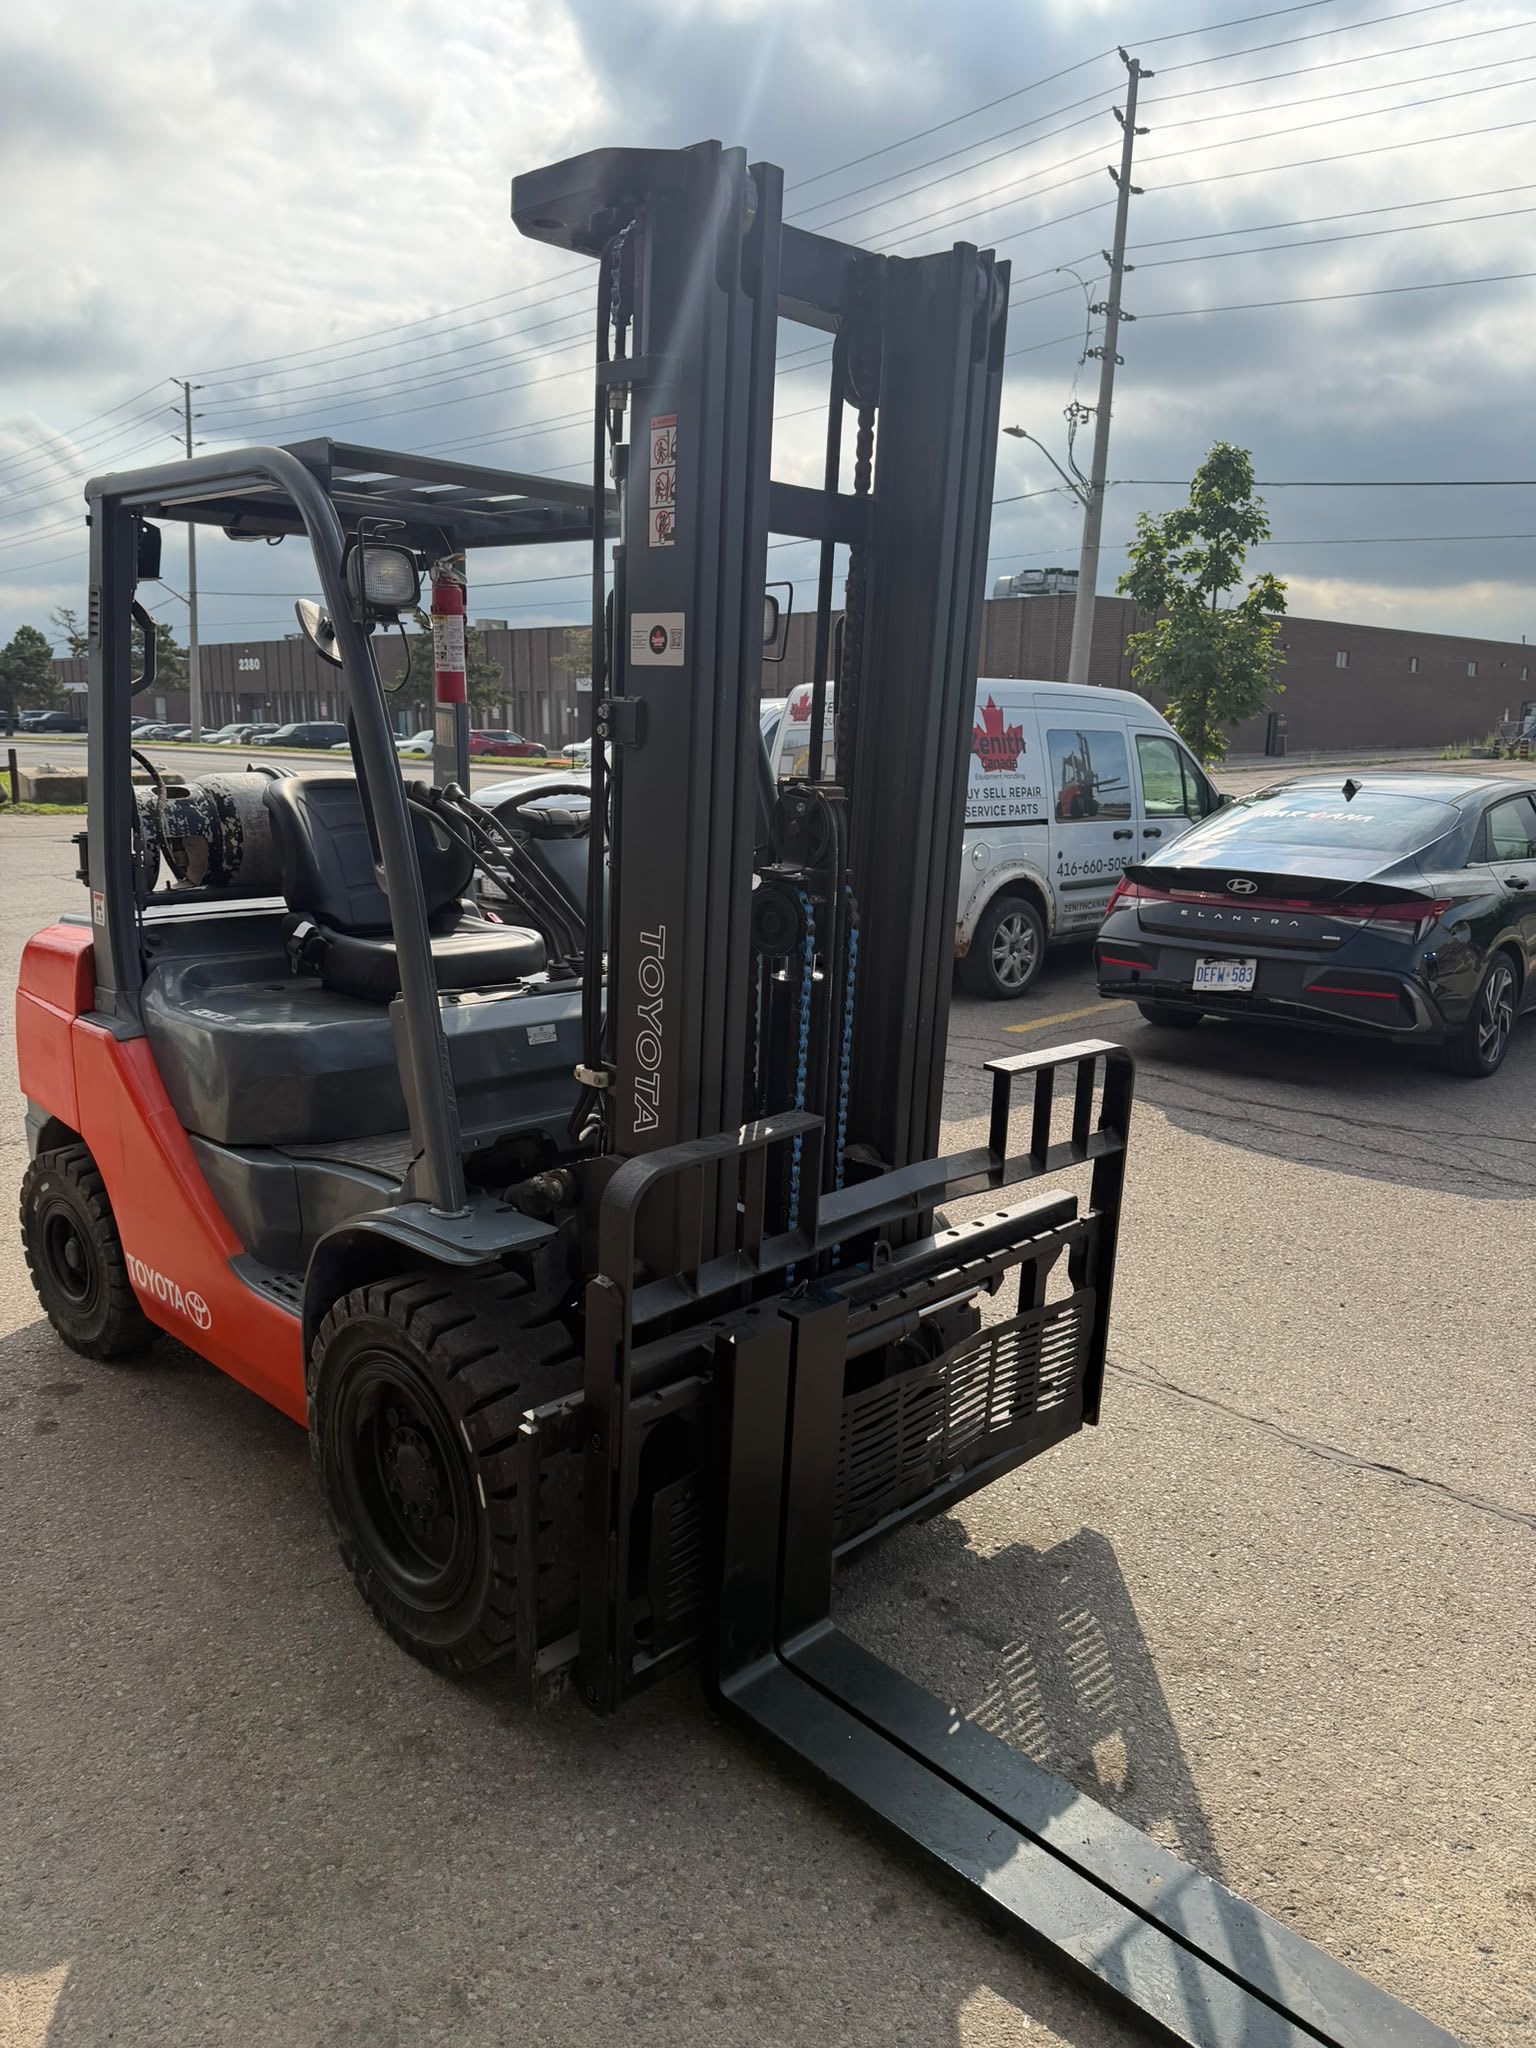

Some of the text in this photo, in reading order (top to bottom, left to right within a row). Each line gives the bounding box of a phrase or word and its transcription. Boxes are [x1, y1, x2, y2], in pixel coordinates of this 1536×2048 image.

[982, 756, 1018, 769] Canada
[975, 773, 1002, 781] Equipment
[968, 786, 1041, 799] UY SELL REPAIR
[966, 803, 1038, 817] SERVICE PARTS
[1057, 856, 1133, 877] 416-660-5054
[1181, 909, 1299, 927] ELANTRA
[1196, 967, 1254, 983] DEFW 583
[634, 925, 666, 1133] TOYOTA
[126, 1252, 187, 1315] TOYOTA
